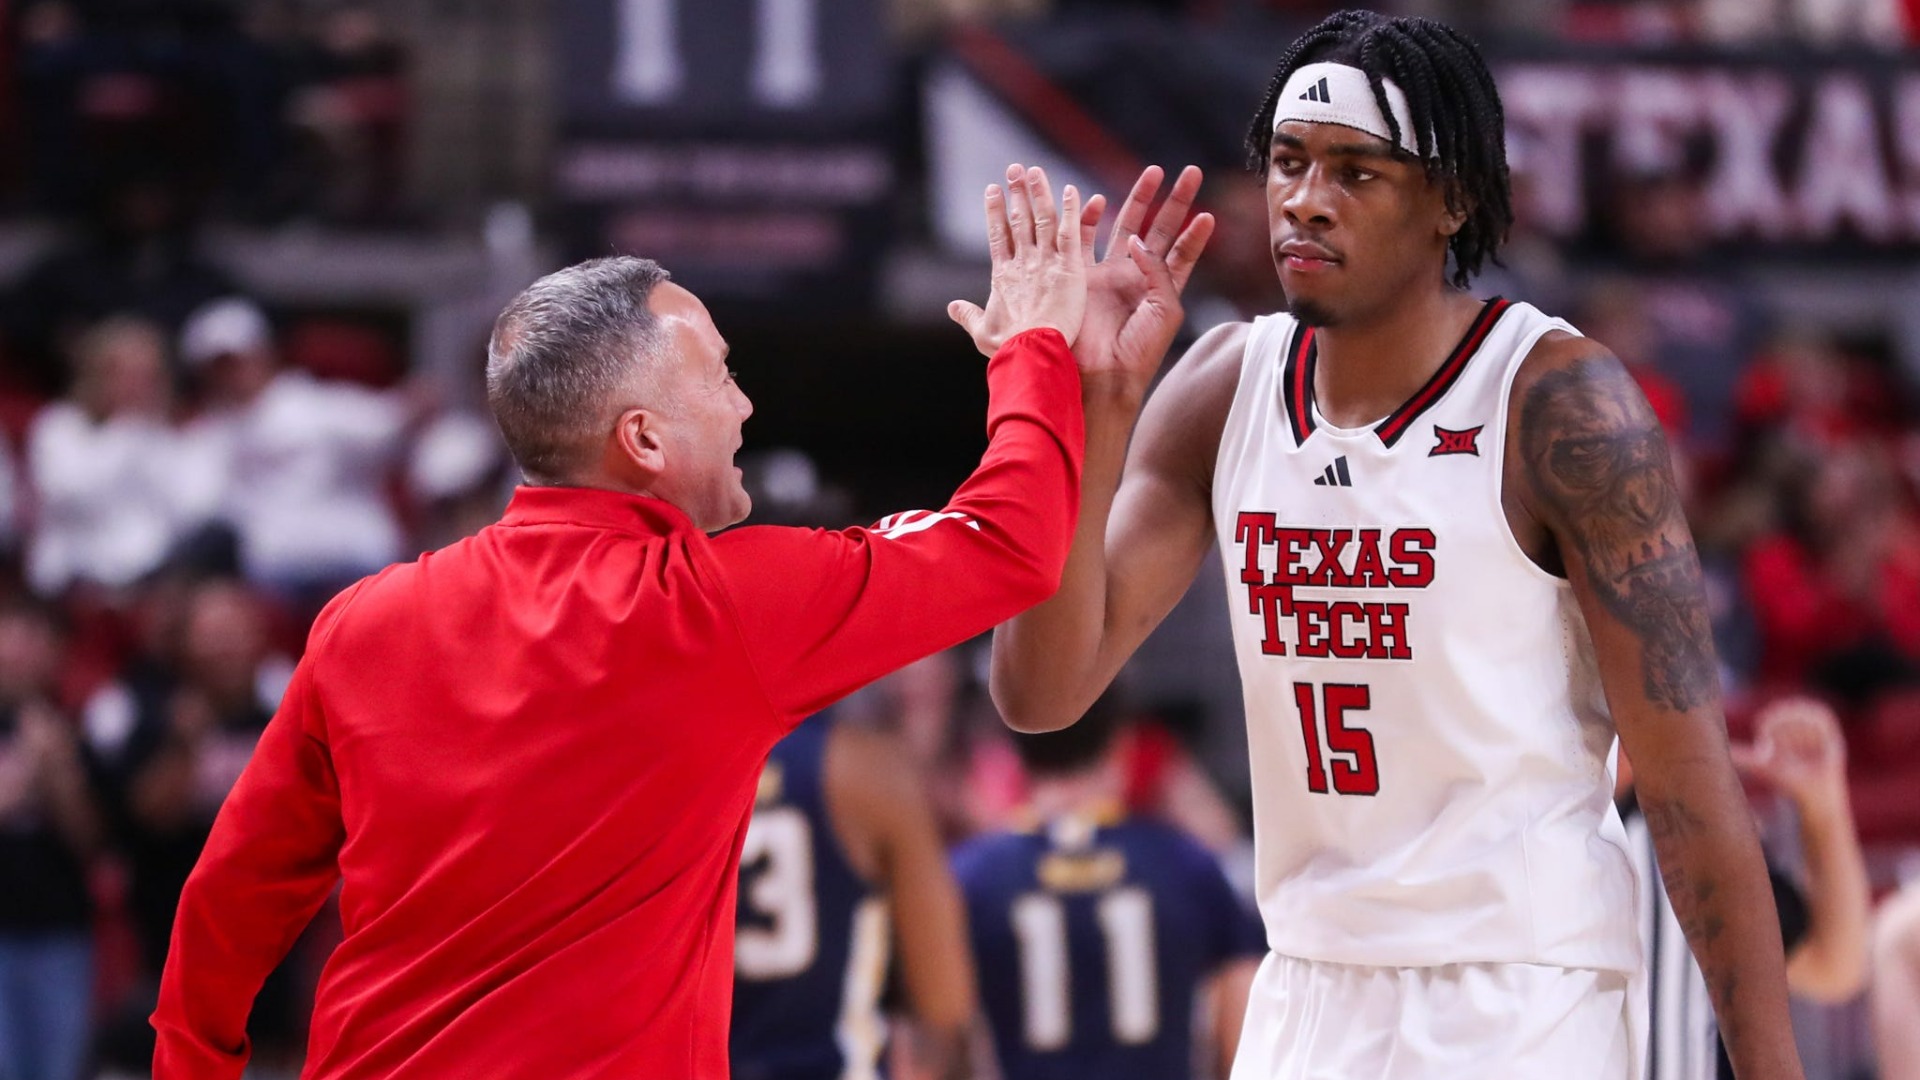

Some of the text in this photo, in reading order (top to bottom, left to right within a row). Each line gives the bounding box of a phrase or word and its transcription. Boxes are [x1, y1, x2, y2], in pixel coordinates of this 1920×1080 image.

[1235, 511, 1437, 588] TEXAS
[1248, 583, 1412, 660] TECH
[1293, 682, 1380, 796] 15
[1011, 886, 1160, 1053] 11
